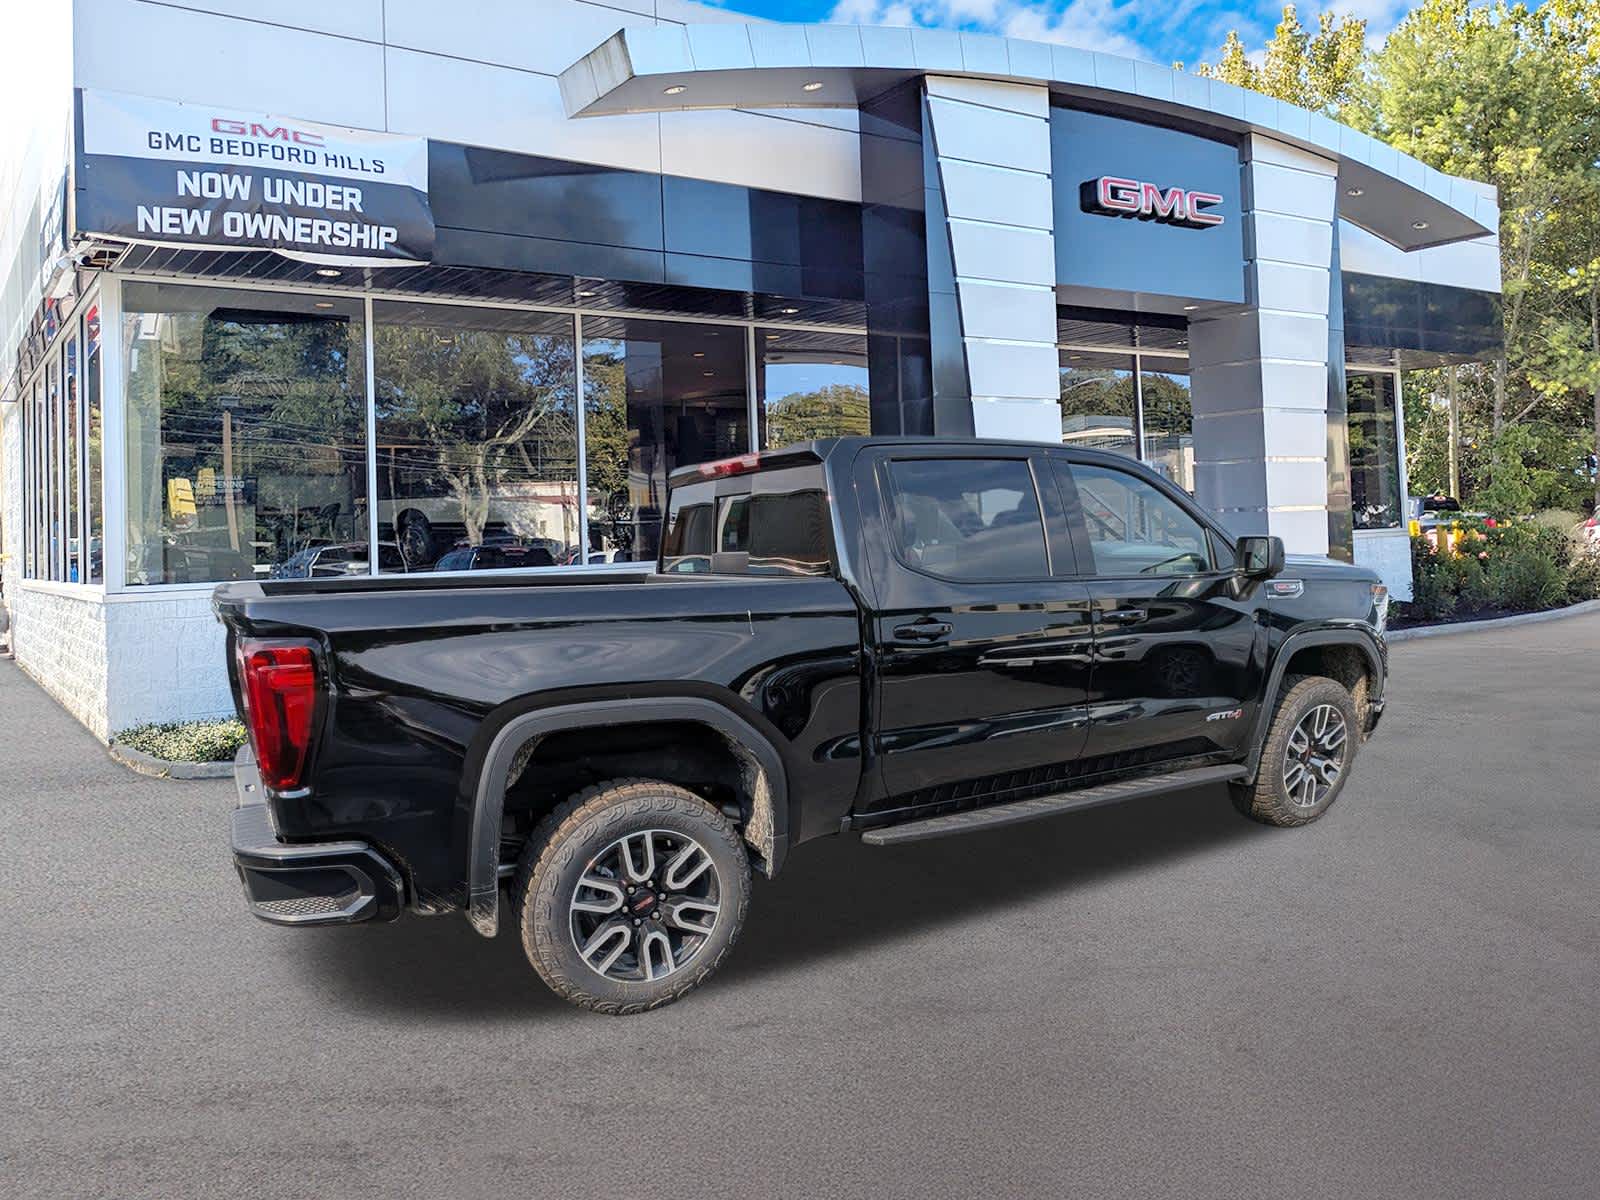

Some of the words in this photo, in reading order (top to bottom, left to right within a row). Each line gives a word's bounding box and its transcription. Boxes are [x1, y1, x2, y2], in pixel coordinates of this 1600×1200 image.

[148, 131, 202, 152] GMC
[210, 137, 317, 165] BEDFORD
[324, 153, 385, 174] HILLS
[211, 118, 326, 148] GMC
[177, 170, 253, 201] NOW
[263, 177, 364, 213] UNDER
[1097, 175, 1225, 225] GMC
[136, 205, 212, 236] NEW
[223, 211, 398, 250] OWNERSHIP
